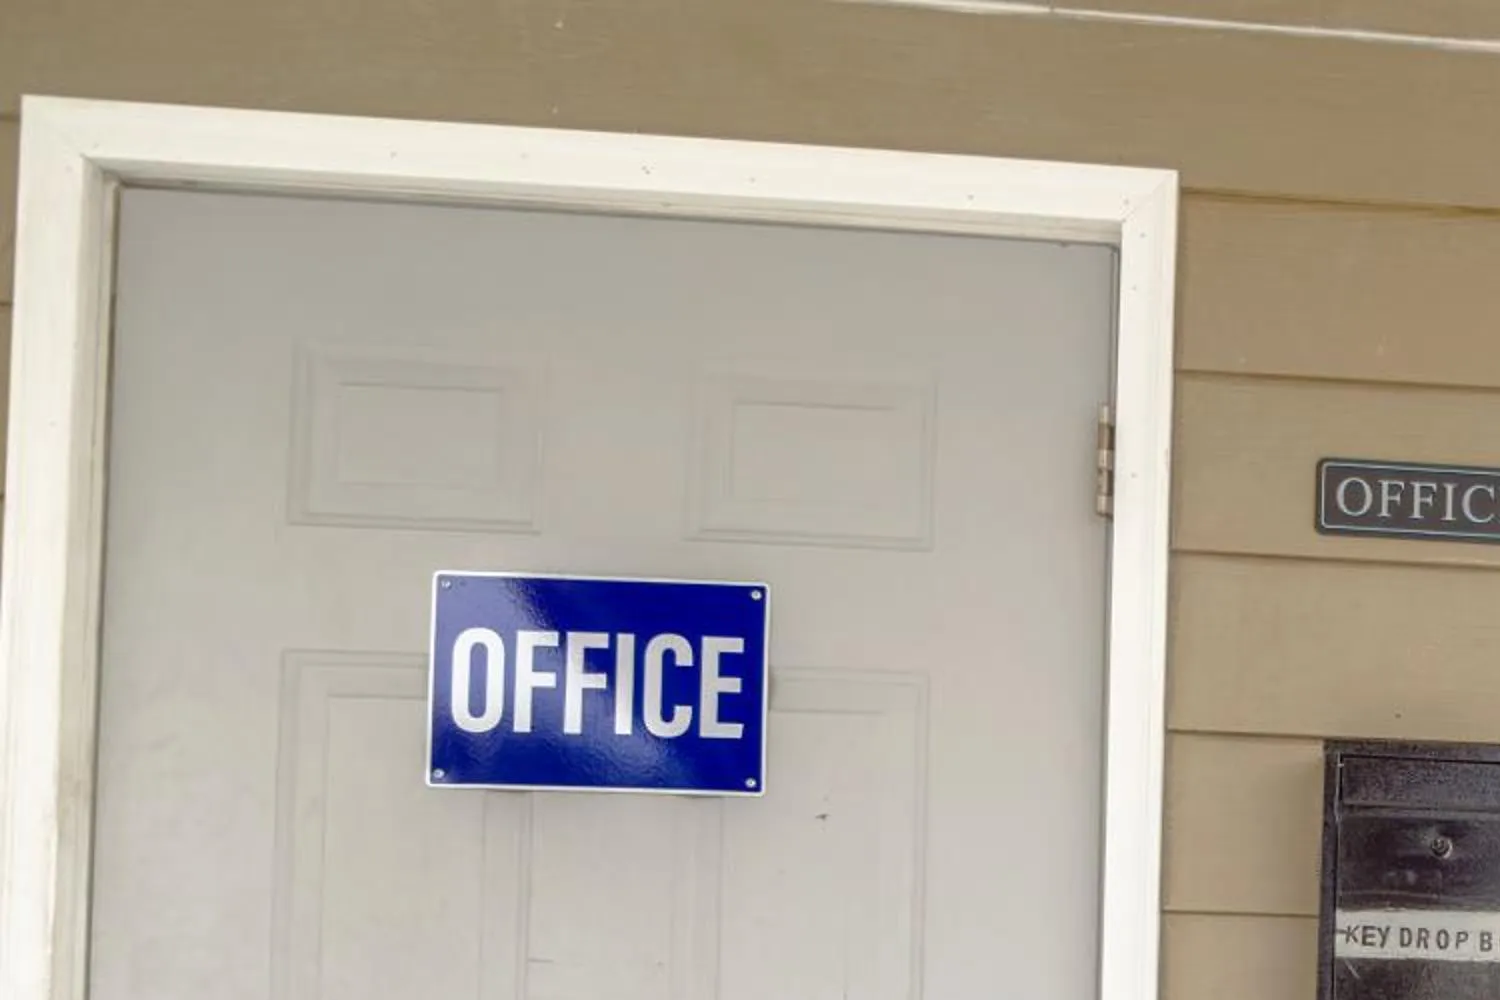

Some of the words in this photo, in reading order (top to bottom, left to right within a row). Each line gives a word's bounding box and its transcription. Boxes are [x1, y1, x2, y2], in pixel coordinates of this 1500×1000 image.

[451, 627, 745, 739] OFFICE
[1345, 925, 1390, 948] KEY
[1400, 927, 1469, 951] DROP
